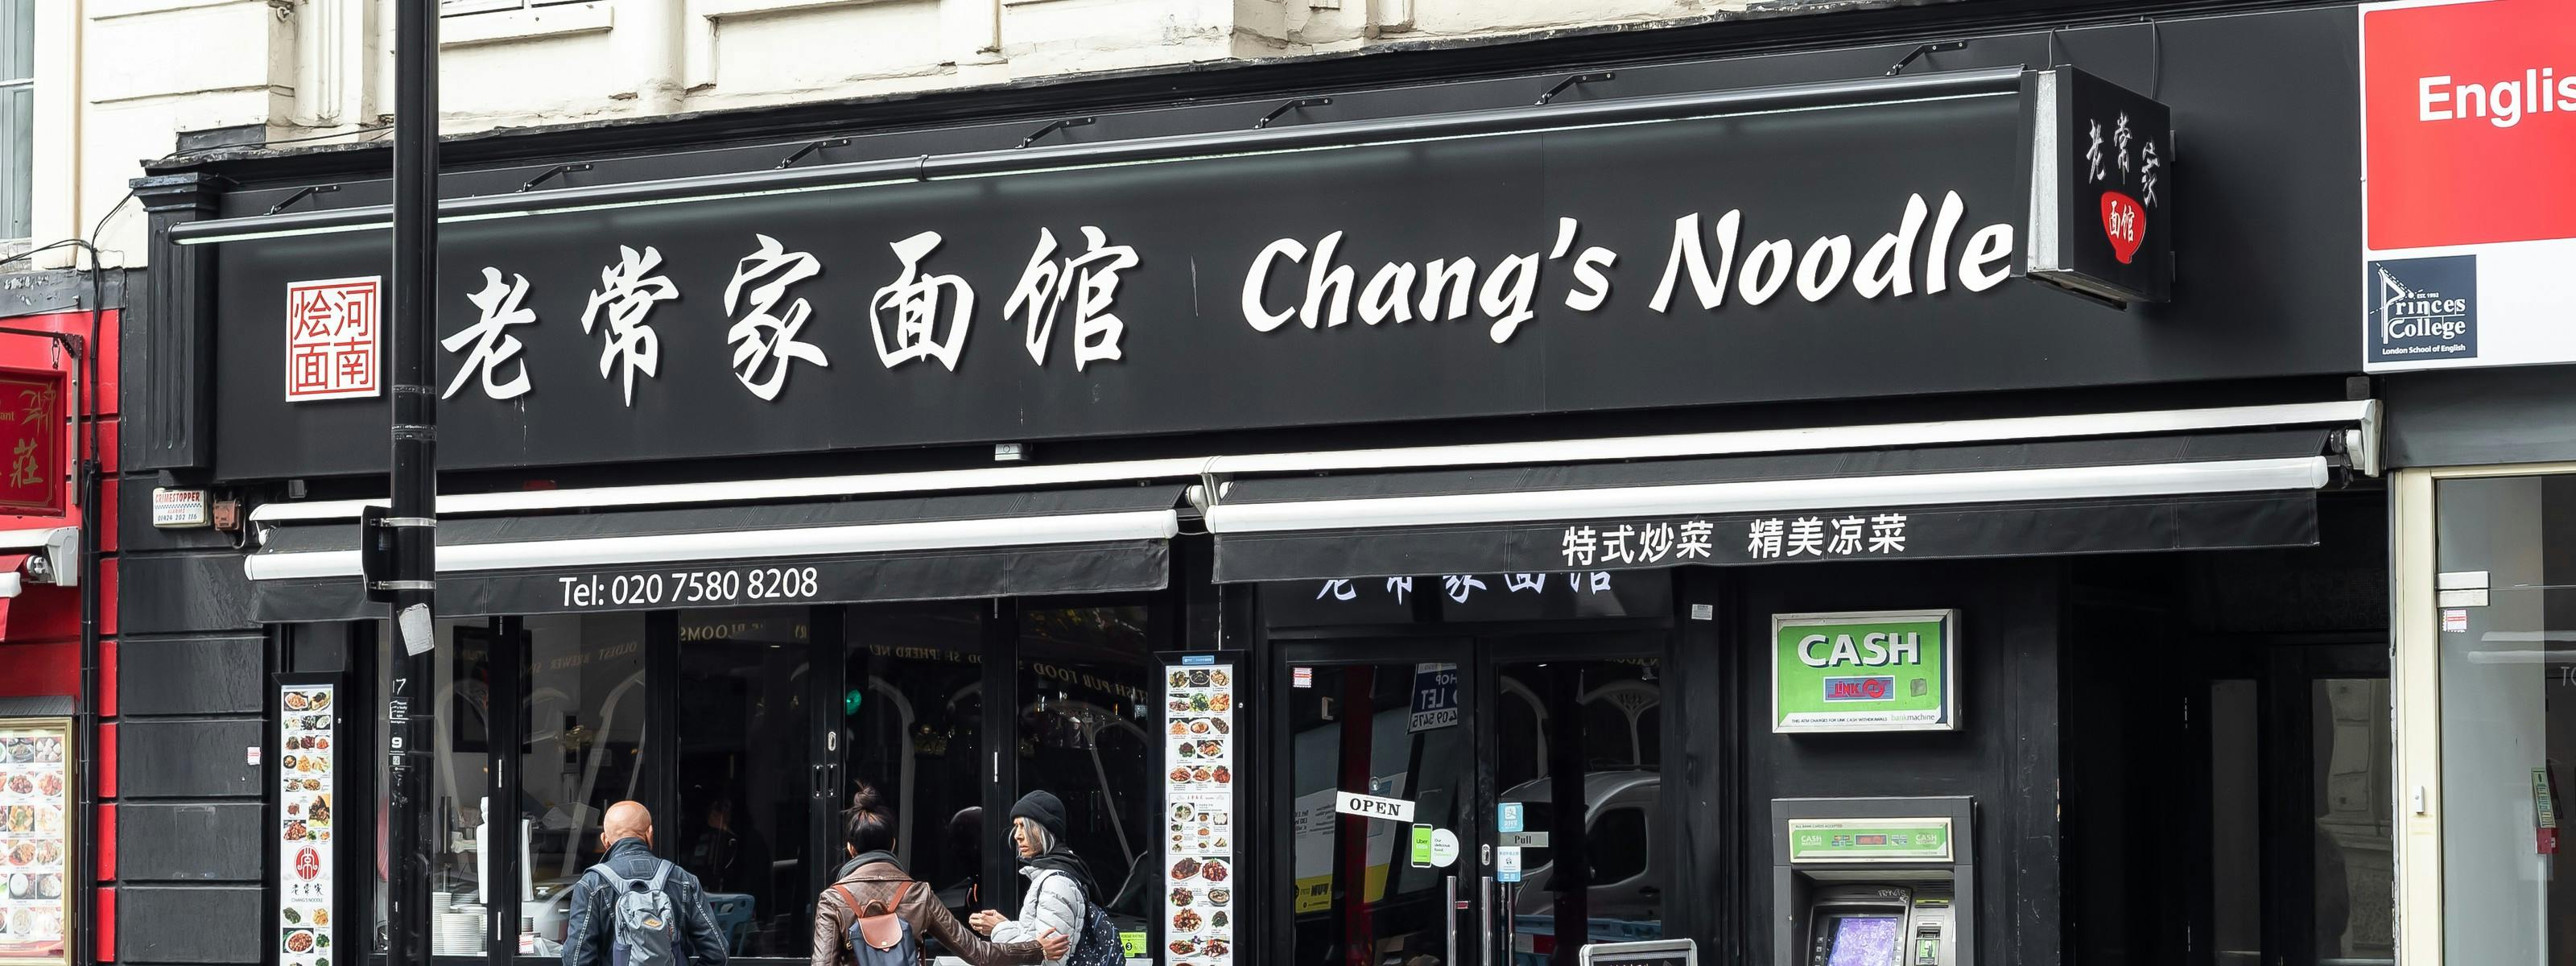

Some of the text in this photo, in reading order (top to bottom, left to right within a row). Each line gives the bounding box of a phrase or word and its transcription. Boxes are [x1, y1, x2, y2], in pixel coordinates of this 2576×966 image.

[2109, 200, 2135, 242] 面馆
[1241, 190, 2013, 344] Chang's Noodle
[441, 225, 1140, 409] 老常家面馆
[2388, 317, 2466, 340] College
[2432, 345, 2440, 353] of
[2441, 344, 2466, 353] English
[155, 492, 200, 503] CRIMESTOPPER
[1562, 513, 1907, 567] 特式炒菜 精美凉菜
[559, 567, 818, 606] Tel: 020 7580 8208
[1798, 632, 1921, 668] CASH
[1834, 681, 1862, 697] LINK
[1891, 713, 1935, 721] bankmachine
[1349, 798, 1402, 816] OPEN
[1514, 836, 1531, 844] Pull
